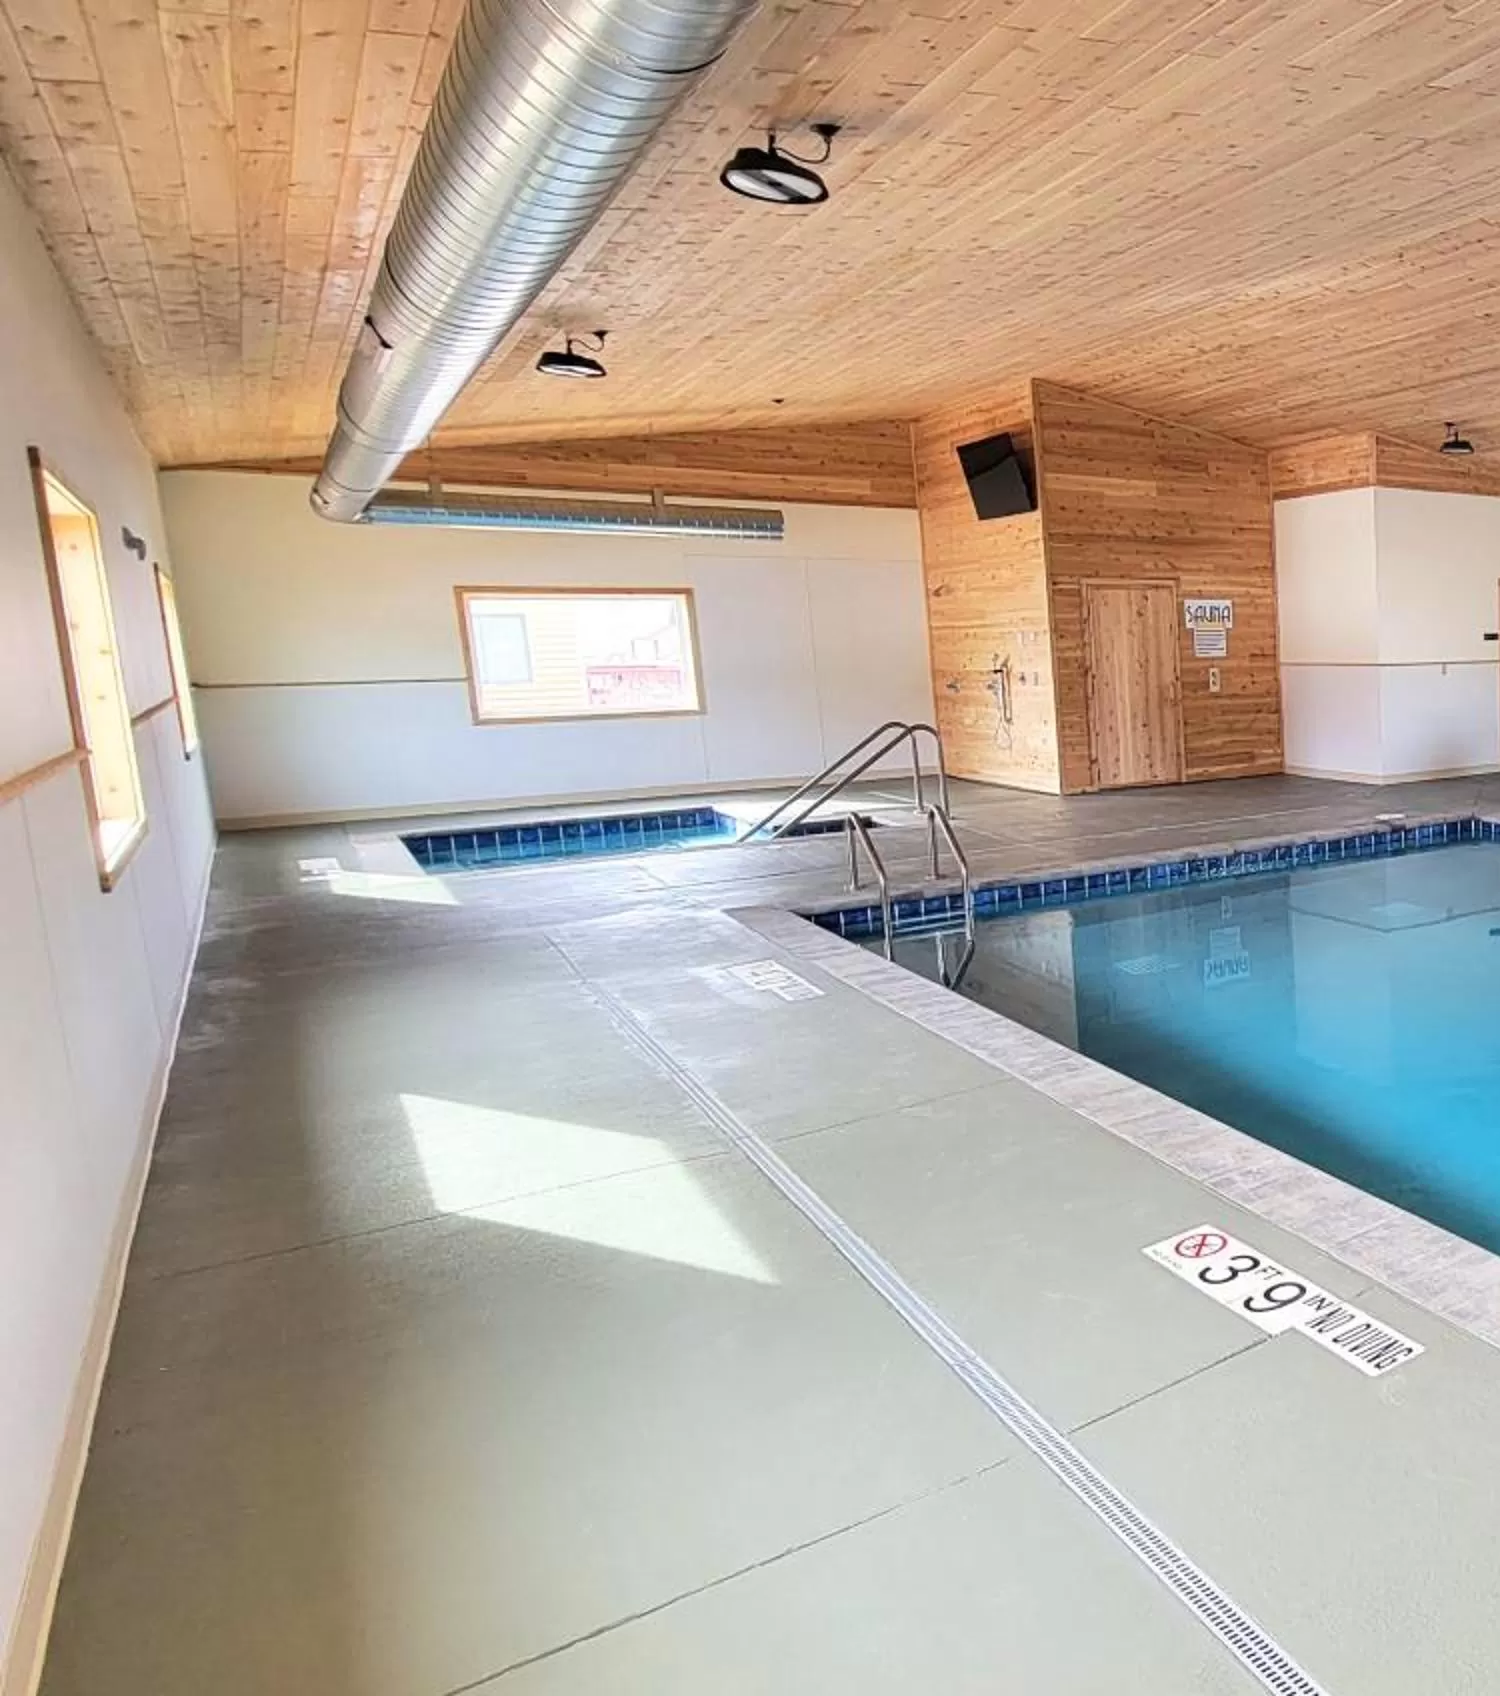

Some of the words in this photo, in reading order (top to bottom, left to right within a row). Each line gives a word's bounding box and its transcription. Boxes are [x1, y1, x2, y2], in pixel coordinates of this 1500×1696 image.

[1185, 604, 1231, 623] SAUNA
[1197, 1254, 1261, 1285] 3
[1254, 1265, 1283, 1281] FT
[1243, 1281, 1307, 1313] 9
[1302, 1293, 1334, 1312] IN
[1304, 1306, 1356, 1334] NO
[1331, 1322, 1414, 1370] DIVING
